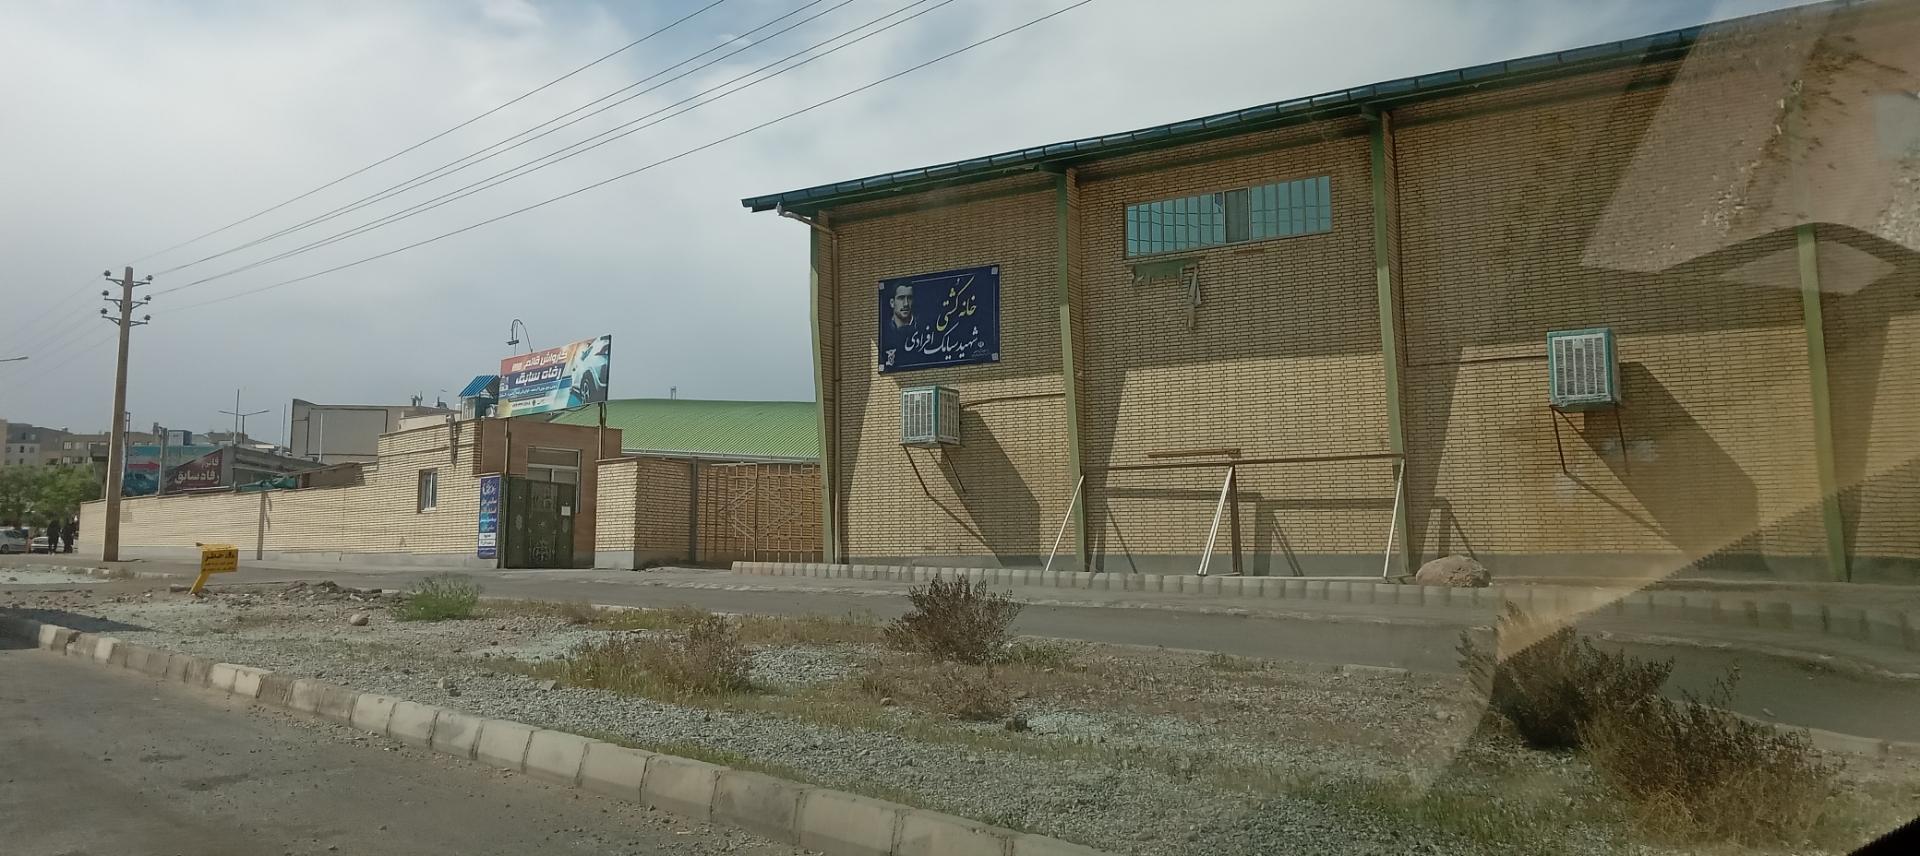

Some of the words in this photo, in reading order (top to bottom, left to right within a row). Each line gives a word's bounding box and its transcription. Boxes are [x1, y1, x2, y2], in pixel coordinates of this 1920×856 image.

[959, 295, 977, 317] خانه
[923, 321, 960, 361] سیامک
[956, 326, 979, 359] شهید
[515, 371, 541, 386] سابق
[541, 366, 562, 380] رفاه
